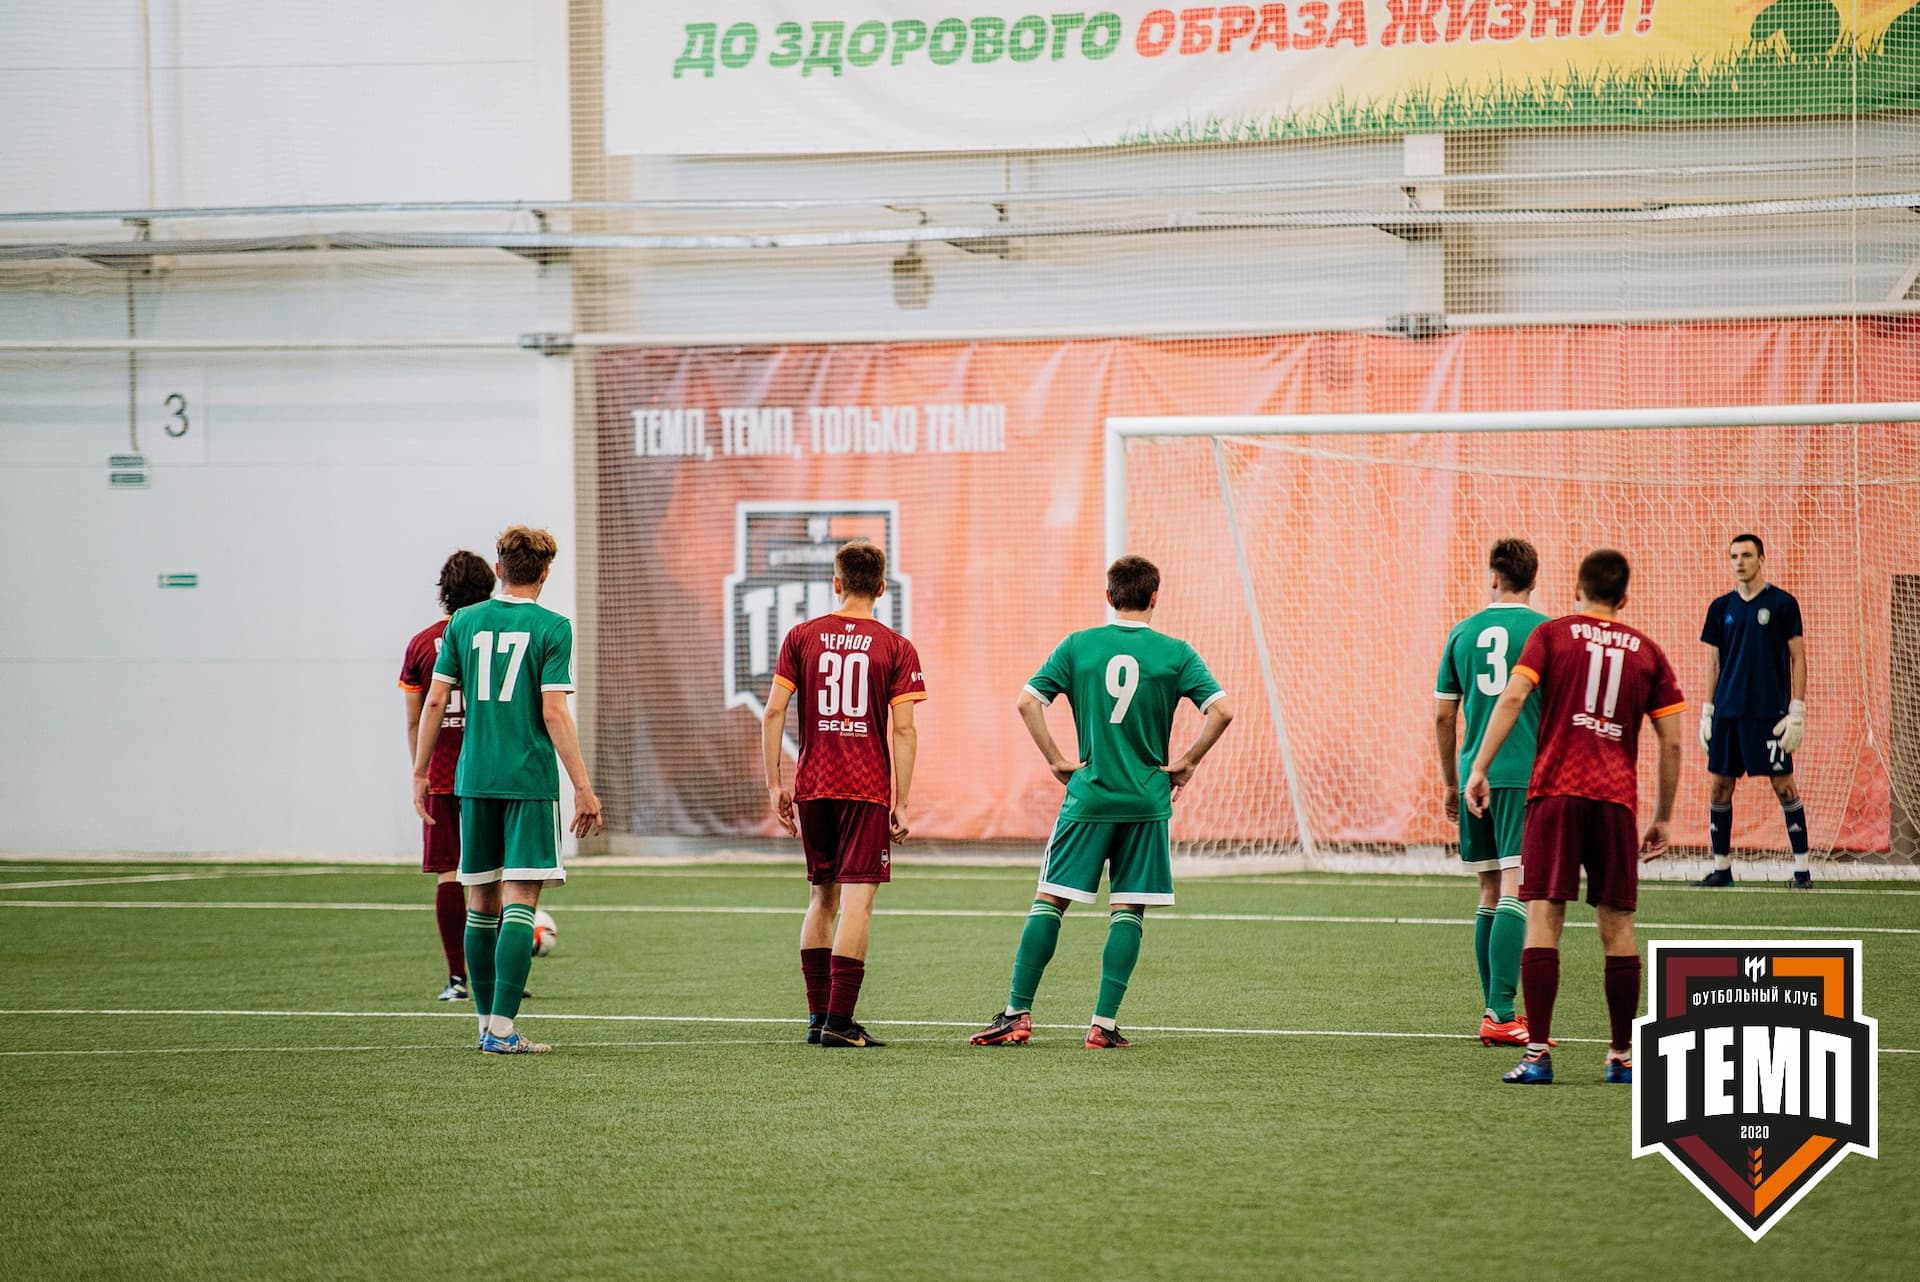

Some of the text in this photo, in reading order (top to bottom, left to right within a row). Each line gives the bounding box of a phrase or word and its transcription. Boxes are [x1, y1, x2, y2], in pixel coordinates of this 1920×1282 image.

[673, 22, 759, 79] ДО
[768, 11, 1122, 78] ЗДОРОВОГО
[1135, 0, 1367, 57] ОБРАЗА
[164, 392, 190, 438] 3
[632, 403, 1007, 461] ТЕМП, ТЕМП, ТОЛЬКО ТЕМП!
[472, 630, 531, 702] 17
[820, 632, 873, 652] ЧЕРНОВ
[1476, 625, 1509, 696] 3
[1570, 623, 1641, 652] РОДИЧЕВ
[817, 651, 870, 718] 30
[1105, 653, 1140, 724] 9
[1585, 641, 1625, 719] 11
[818, 719, 868, 733] SEUS
